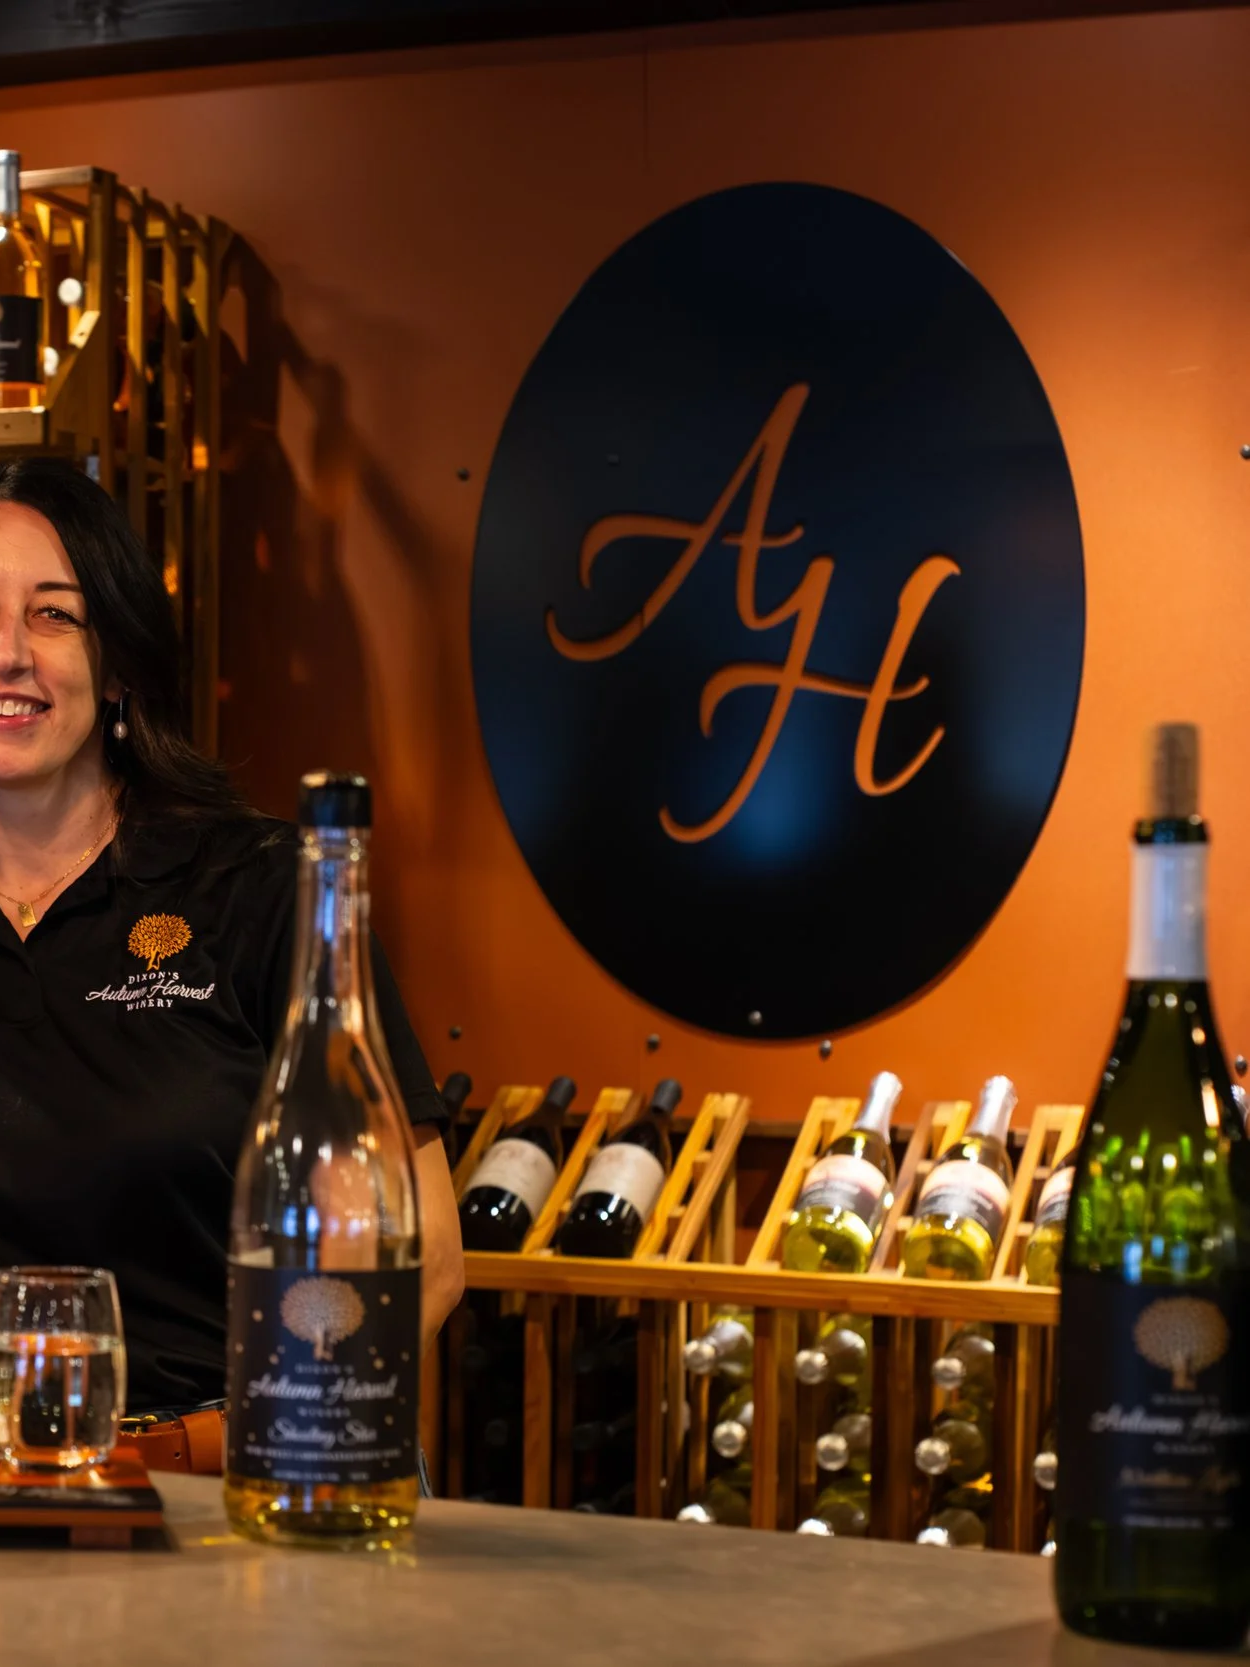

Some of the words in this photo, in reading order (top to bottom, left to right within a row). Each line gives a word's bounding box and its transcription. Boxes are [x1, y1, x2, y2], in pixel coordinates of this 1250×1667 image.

[548, 382, 962, 844] AH
[128, 971, 180, 984] DIXON'S
[85, 984, 148, 1001] Autumn
[146, 978, 215, 1001] Harvest
[126, 998, 174, 1012] WINERY
